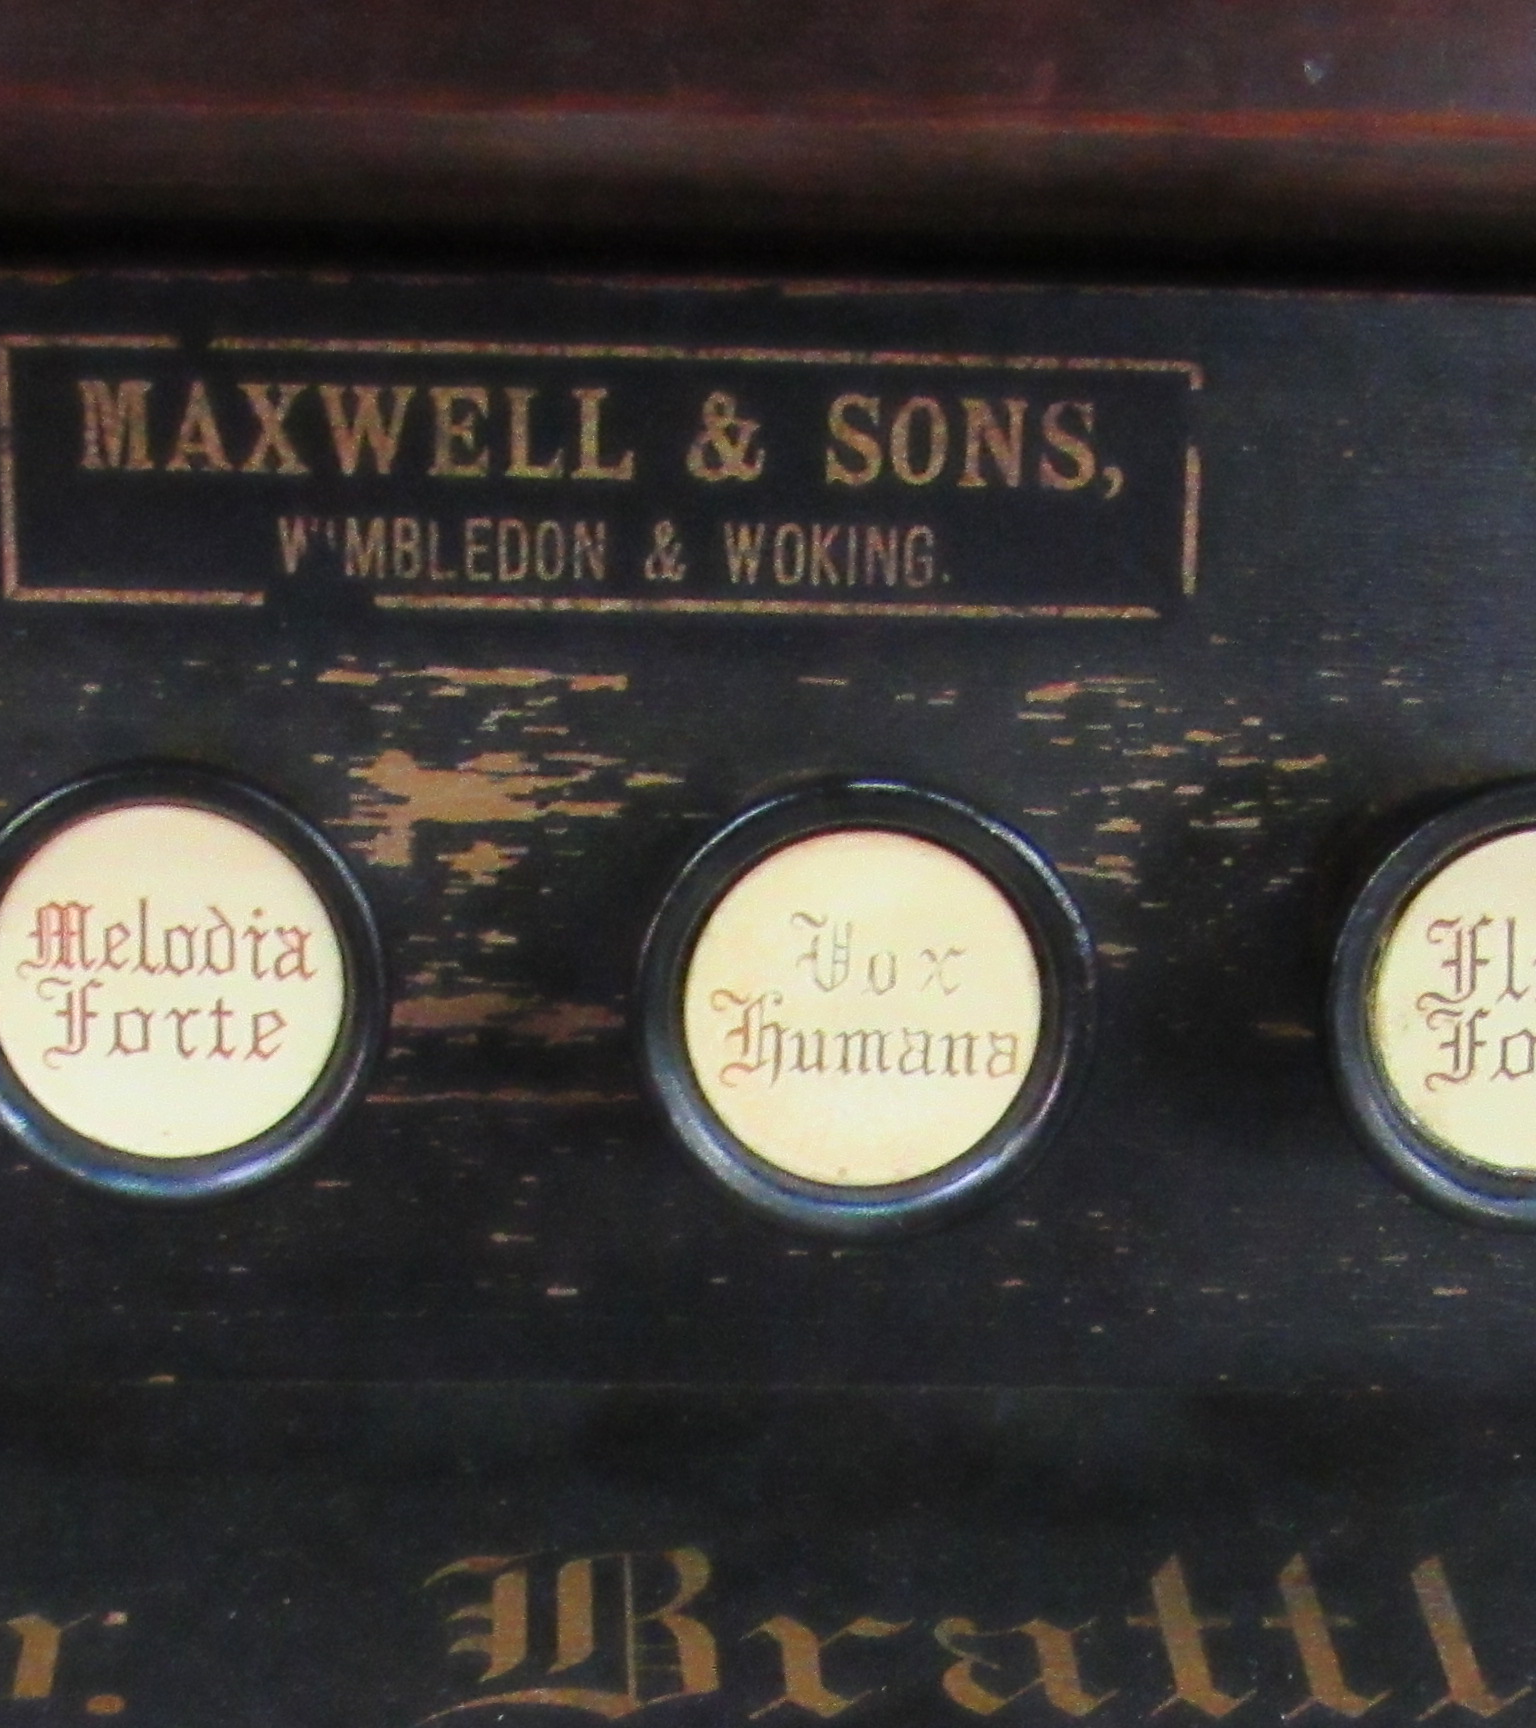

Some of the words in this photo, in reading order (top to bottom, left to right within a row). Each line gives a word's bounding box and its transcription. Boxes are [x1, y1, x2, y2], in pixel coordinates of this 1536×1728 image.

[78, 378, 636, 484] MAXWELL
[685, 390, 767, 484] &
[822, 390, 1126, 498] SONS,
[644, 523, 687, 582] &
[16, 897, 317, 982] Melodia
[790, 910, 966, 998] Vox
[36, 976, 289, 1071] Forte
[710, 988, 1019, 1090] Humana
